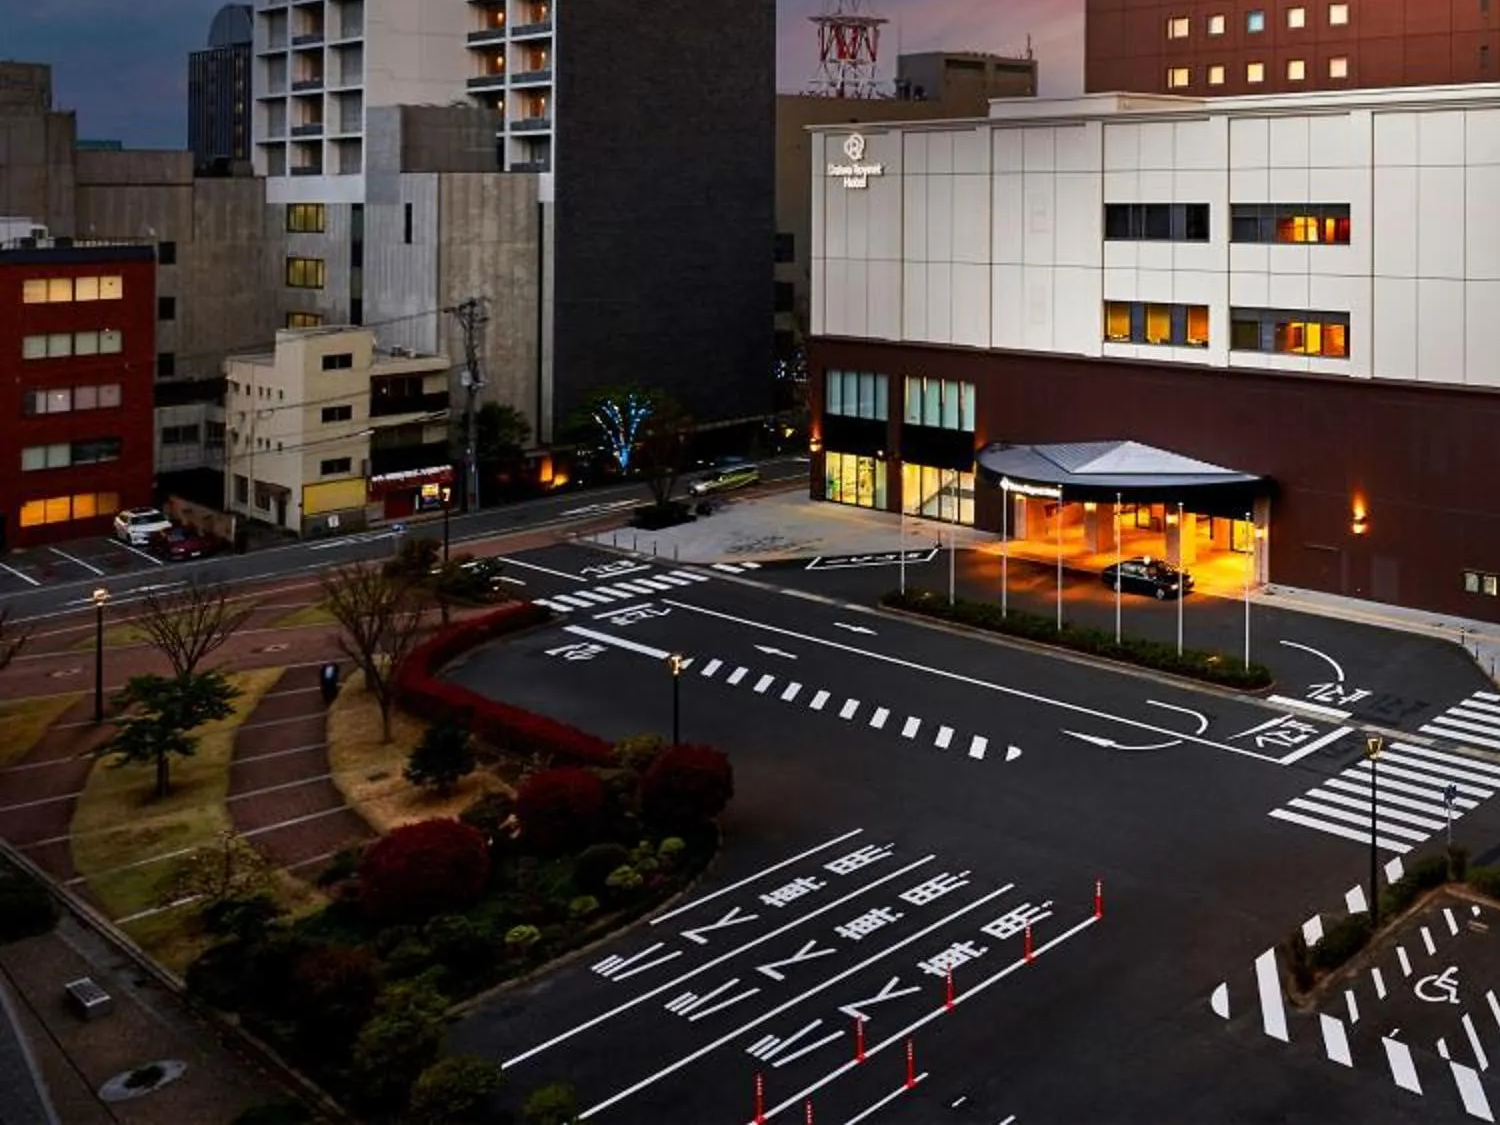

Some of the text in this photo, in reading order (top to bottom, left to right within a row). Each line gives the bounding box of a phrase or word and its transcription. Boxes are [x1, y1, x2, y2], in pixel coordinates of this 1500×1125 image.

[591, 842, 895, 982] バス専用
[664, 870, 971, 1022] バス専用
